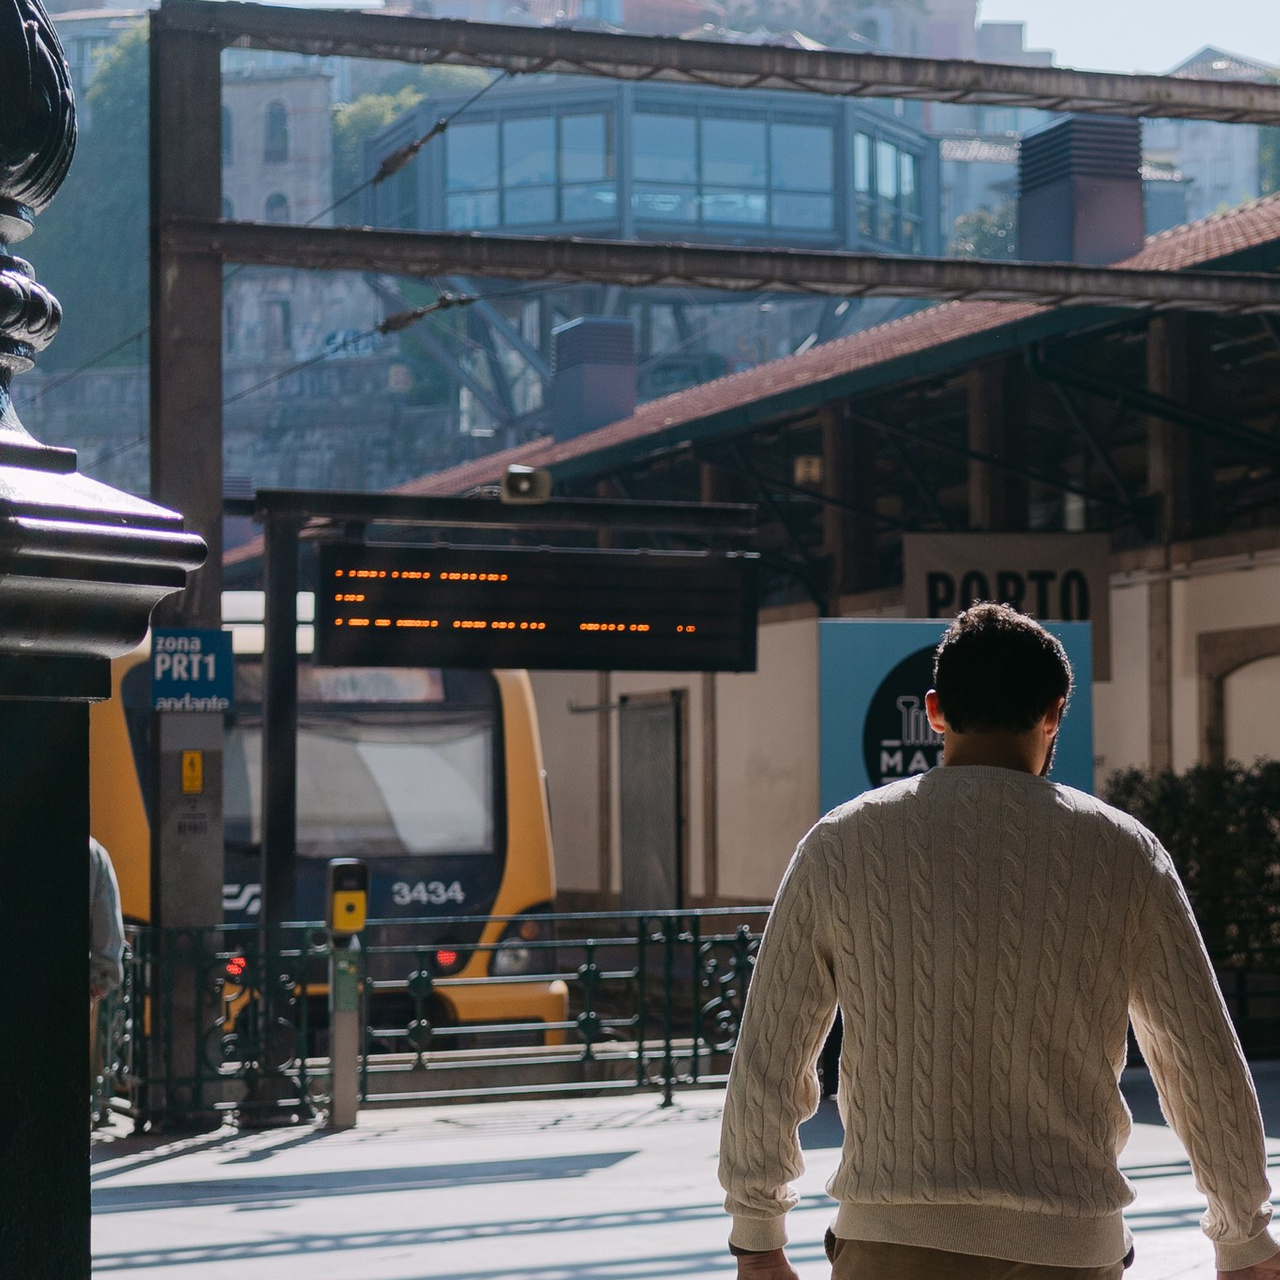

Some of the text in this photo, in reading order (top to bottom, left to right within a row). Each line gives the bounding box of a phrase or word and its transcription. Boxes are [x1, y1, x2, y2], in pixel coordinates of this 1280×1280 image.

[926, 568, 1091, 621] PORTO
[155, 636, 202, 653] zona
[154, 652, 216, 681] PRT1
[155, 692, 230, 713] andante
[390, 880, 466, 906] 3434
